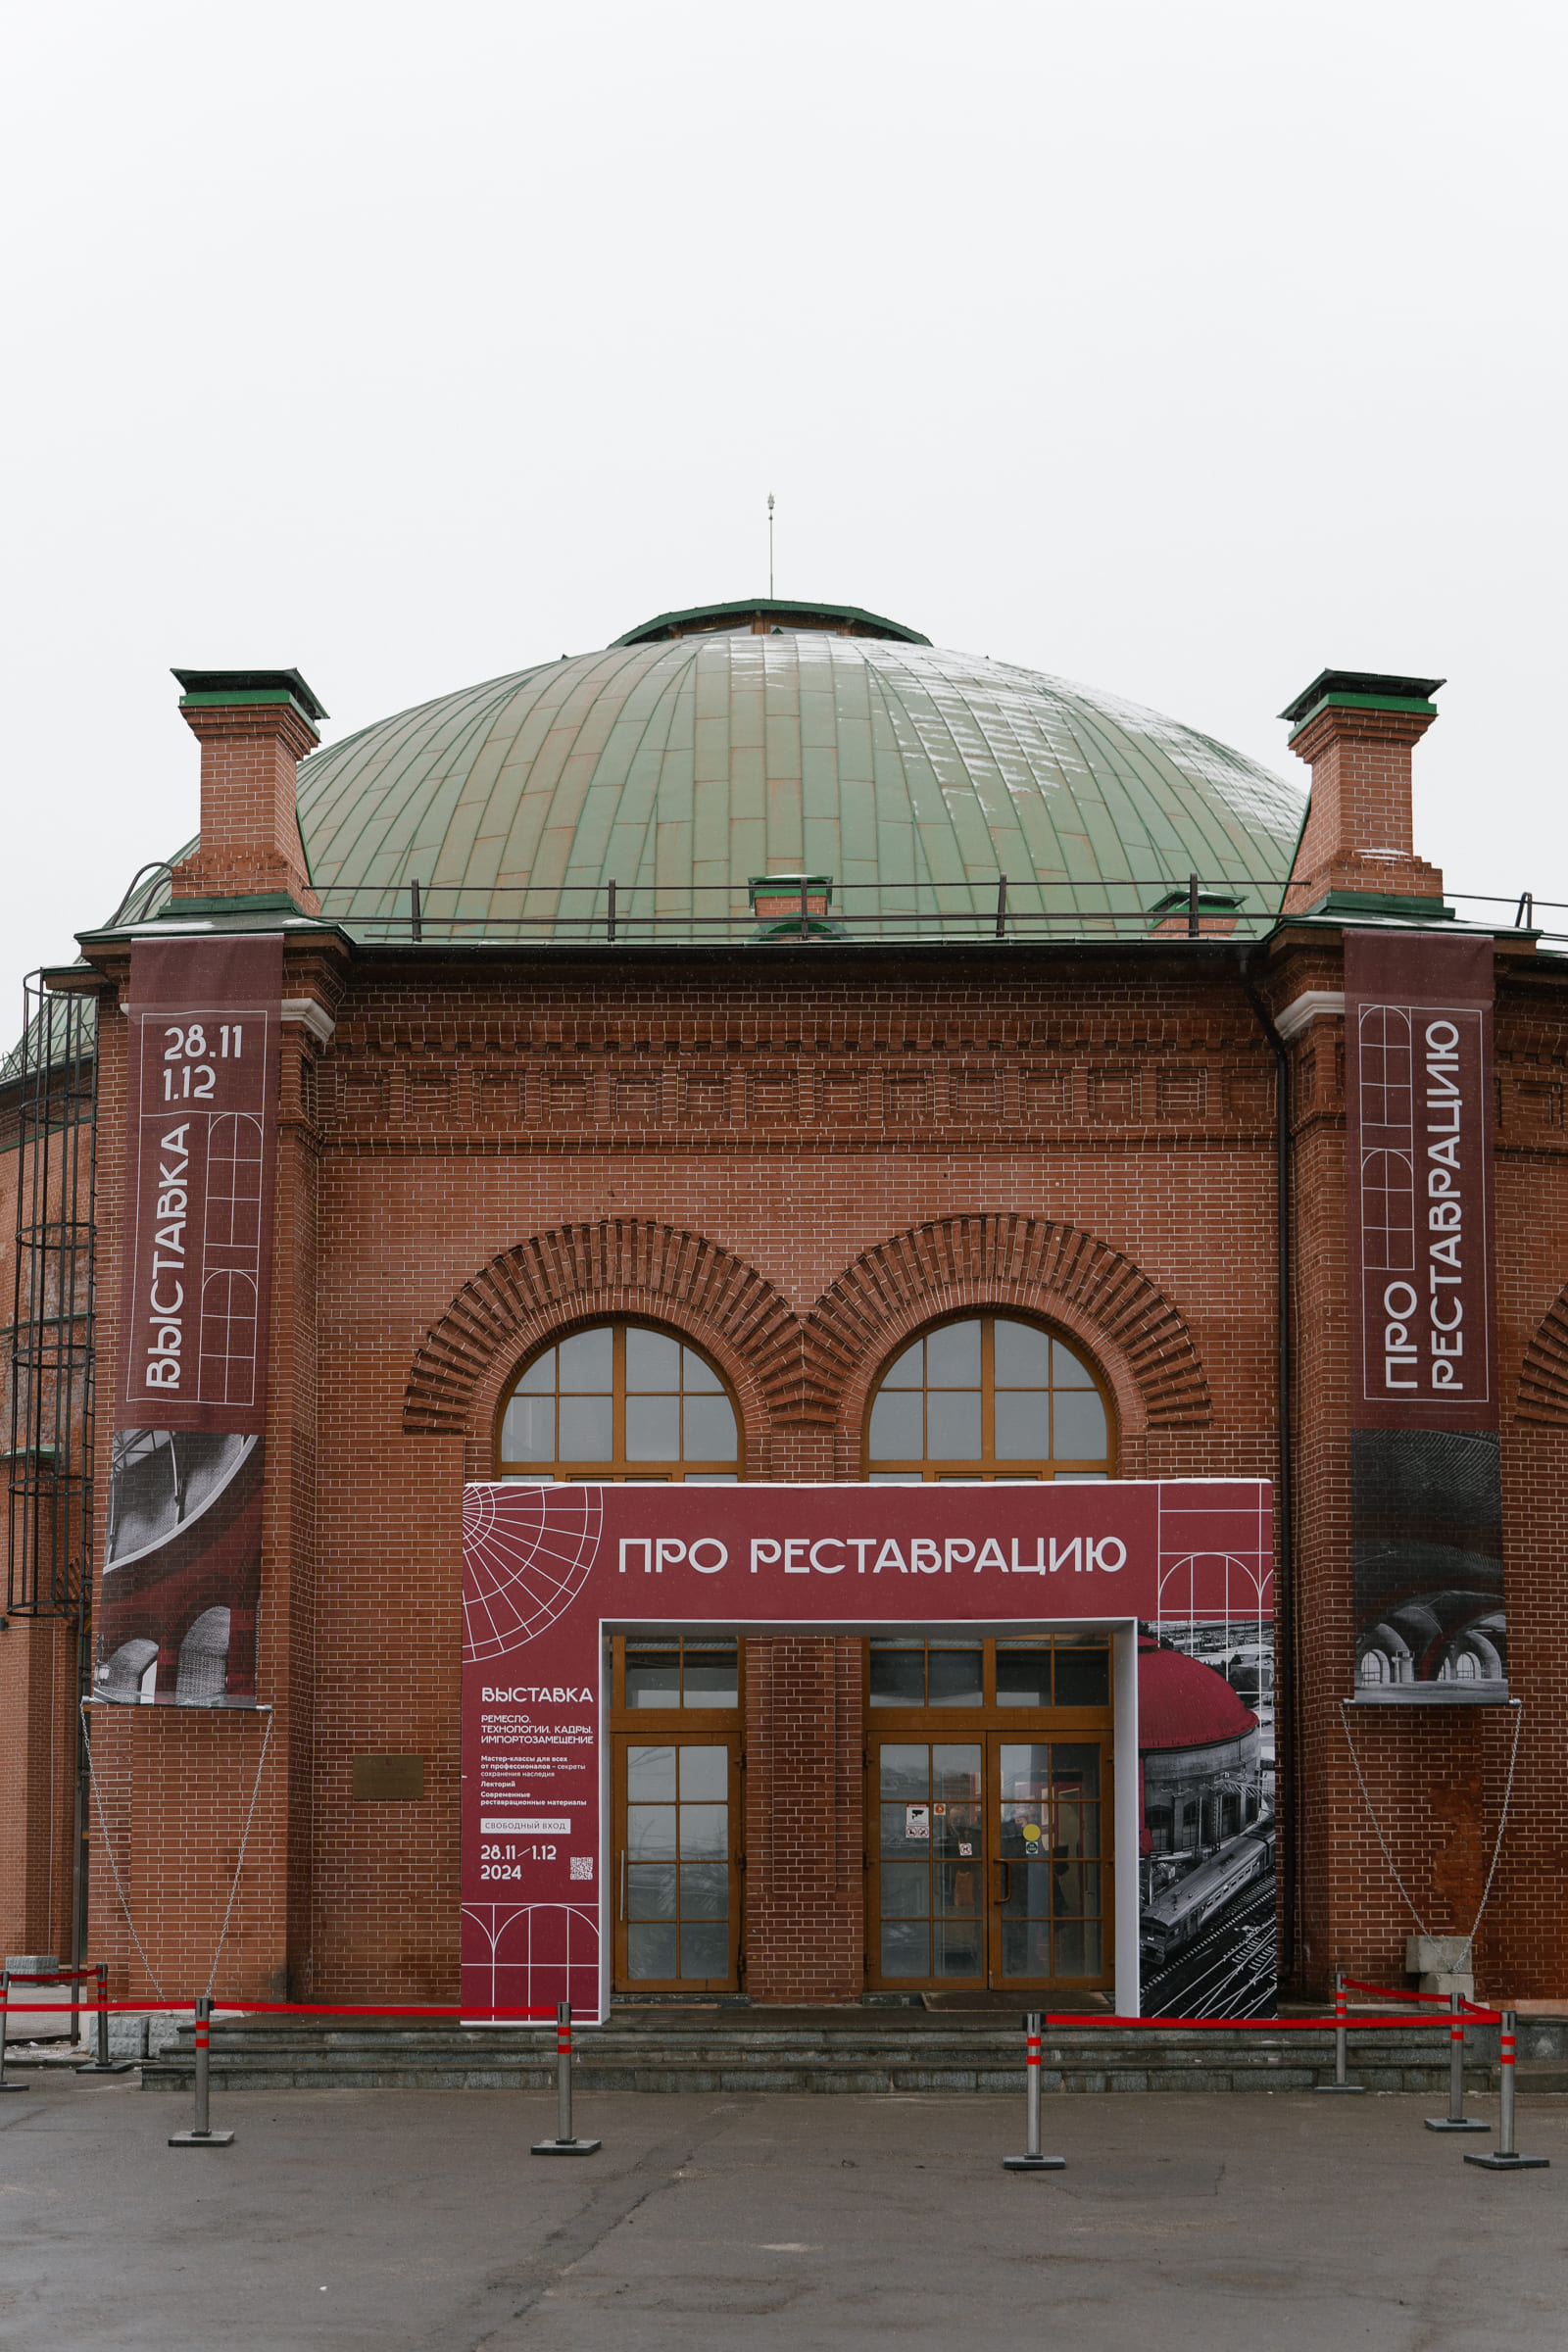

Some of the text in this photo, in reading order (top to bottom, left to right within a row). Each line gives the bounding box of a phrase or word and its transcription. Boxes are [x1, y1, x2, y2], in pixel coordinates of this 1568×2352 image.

[164, 1024, 242, 1060] 28.11
[163, 1064, 217, 1102] 1.12
[1425, 1020, 1464, 1390] РЕСТАВРАЦИЮ
[145, 1122, 190, 1389] ВЫСТАВКА
[1383, 1281, 1418, 1389] ПРО
[618, 1536, 1127, 1576] ПРО РЕСТАВРАЦИЮ
[481, 1687, 594, 1703] ВЫСТАВКА
[480, 1714, 532, 1724] РЕМЕСЛО.
[480, 1725, 593, 1735] ТЕХНОЛОГИИ. КАДРЫ.
[480, 1736, 594, 1744] ИМПОРТОЗАМЕЩЕНИЕ
[490, 1762, 551, 1771] профессионалов
[480, 1780, 516, 1788] Лекторий
[480, 1790, 531, 1799] Современные
[484, 1821, 566, 1831] СВОБОДНЫЙ ВХОД
[480, 1864, 522, 1881] 2024
